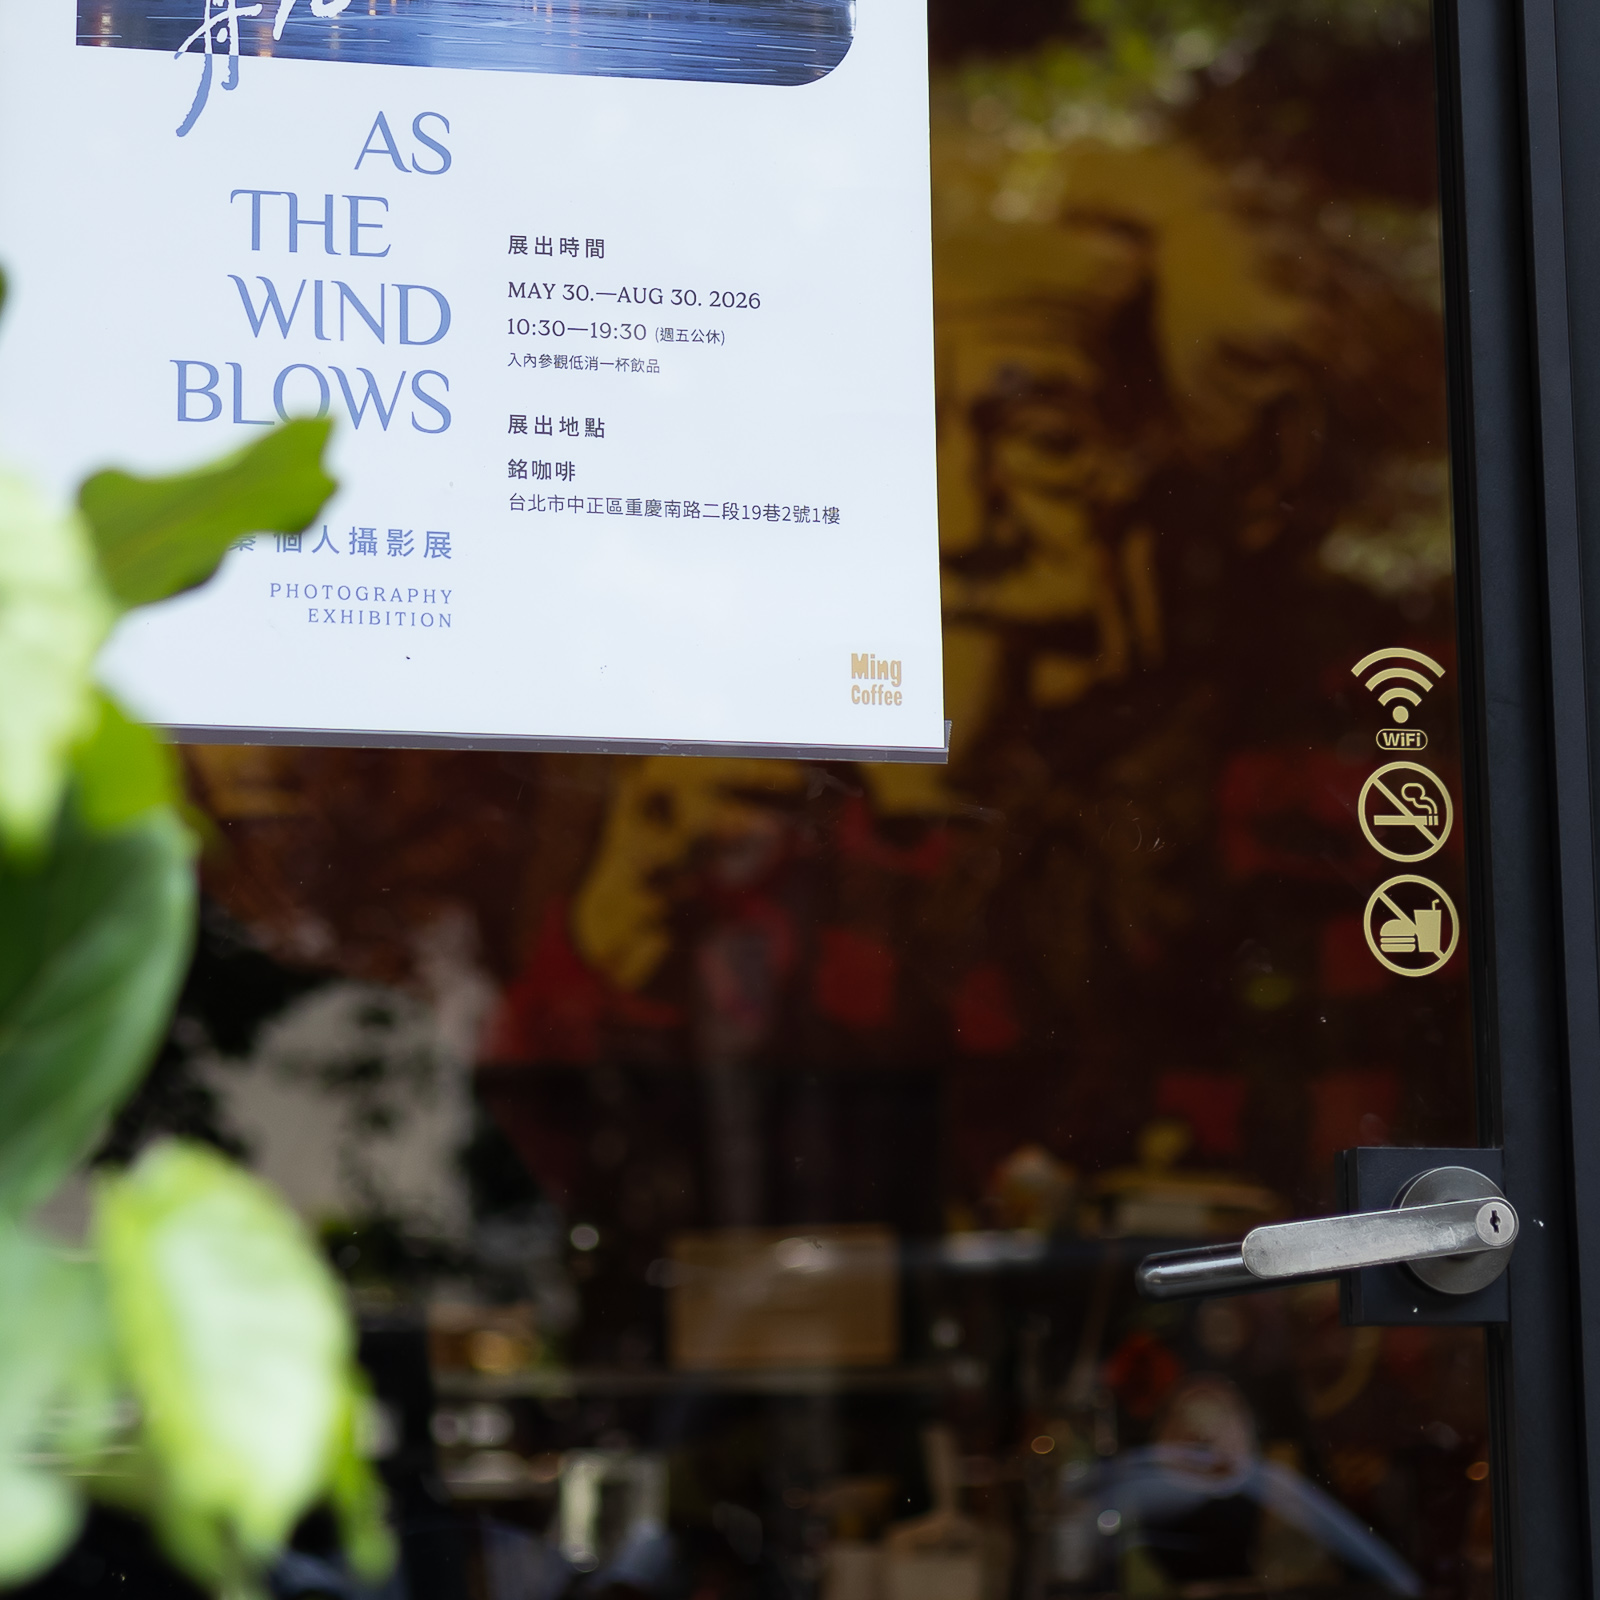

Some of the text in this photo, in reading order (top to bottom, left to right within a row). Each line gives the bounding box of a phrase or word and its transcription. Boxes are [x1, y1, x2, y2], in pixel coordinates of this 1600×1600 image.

[354, 110, 452, 175] AS
[230, 189, 391, 258] THE
[507, 234, 606, 259] 展出時間
[507, 281, 556, 300] MAY
[670, 289, 703, 307] 30.
[709, 290, 761, 310] 2026
[227, 274, 452, 346] WIND
[654, 326, 726, 346] (週五公休)
[169, 360, 452, 434] BLOWS
[507, 414, 606, 439] 展出地點
[507, 458, 577, 482] 銘咖啡
[509, 492, 841, 525] 台北市中正區重慶南路二段19巷2號1樓
[269, 582, 452, 604] PHOTOGRAPHY
[307, 608, 452, 628] EXHIBITION
[850, 652, 902, 688] Ming
[851, 683, 903, 707] Coffee
[1382, 732, 1421, 747] WiFi
